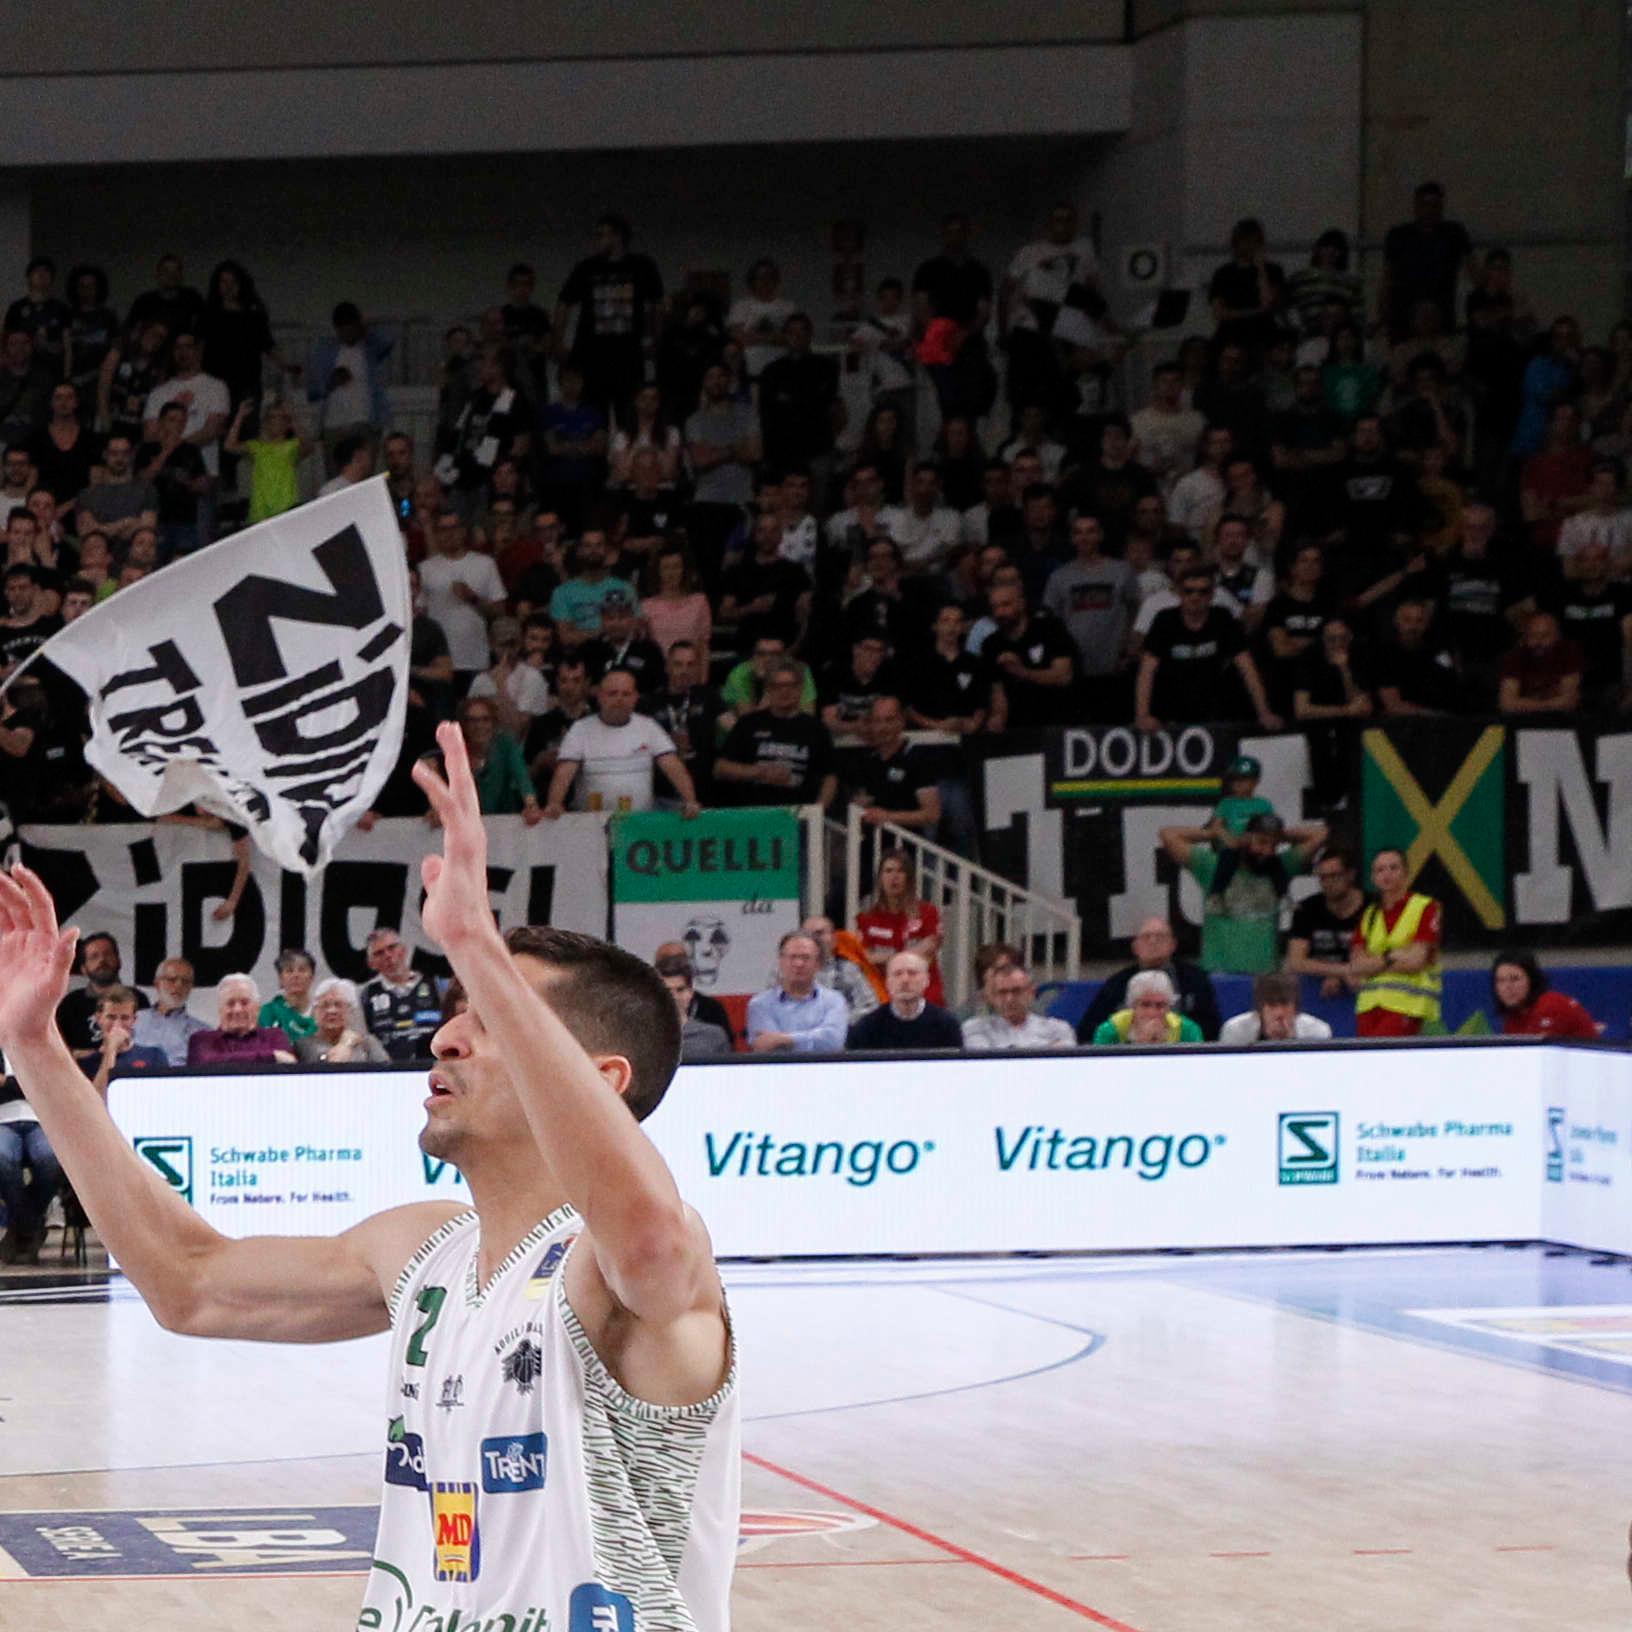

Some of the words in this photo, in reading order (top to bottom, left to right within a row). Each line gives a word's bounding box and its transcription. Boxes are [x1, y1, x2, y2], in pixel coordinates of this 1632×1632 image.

[1062, 728, 1215, 777] DODO
[626, 836, 784, 876] QUELLI
[1356, 1122, 1439, 1139] Schwabe
[1444, 1120, 1513, 1137] Pharma
[210, 1147, 289, 1163] Schwabe
[294, 1145, 363, 1162] Pharma
[210, 1169, 258, 1187] Italia
[406, 1285, 448, 1367] 2
[136, 1513, 374, 1571] LBA
[437, 1513, 473, 1547] MD
